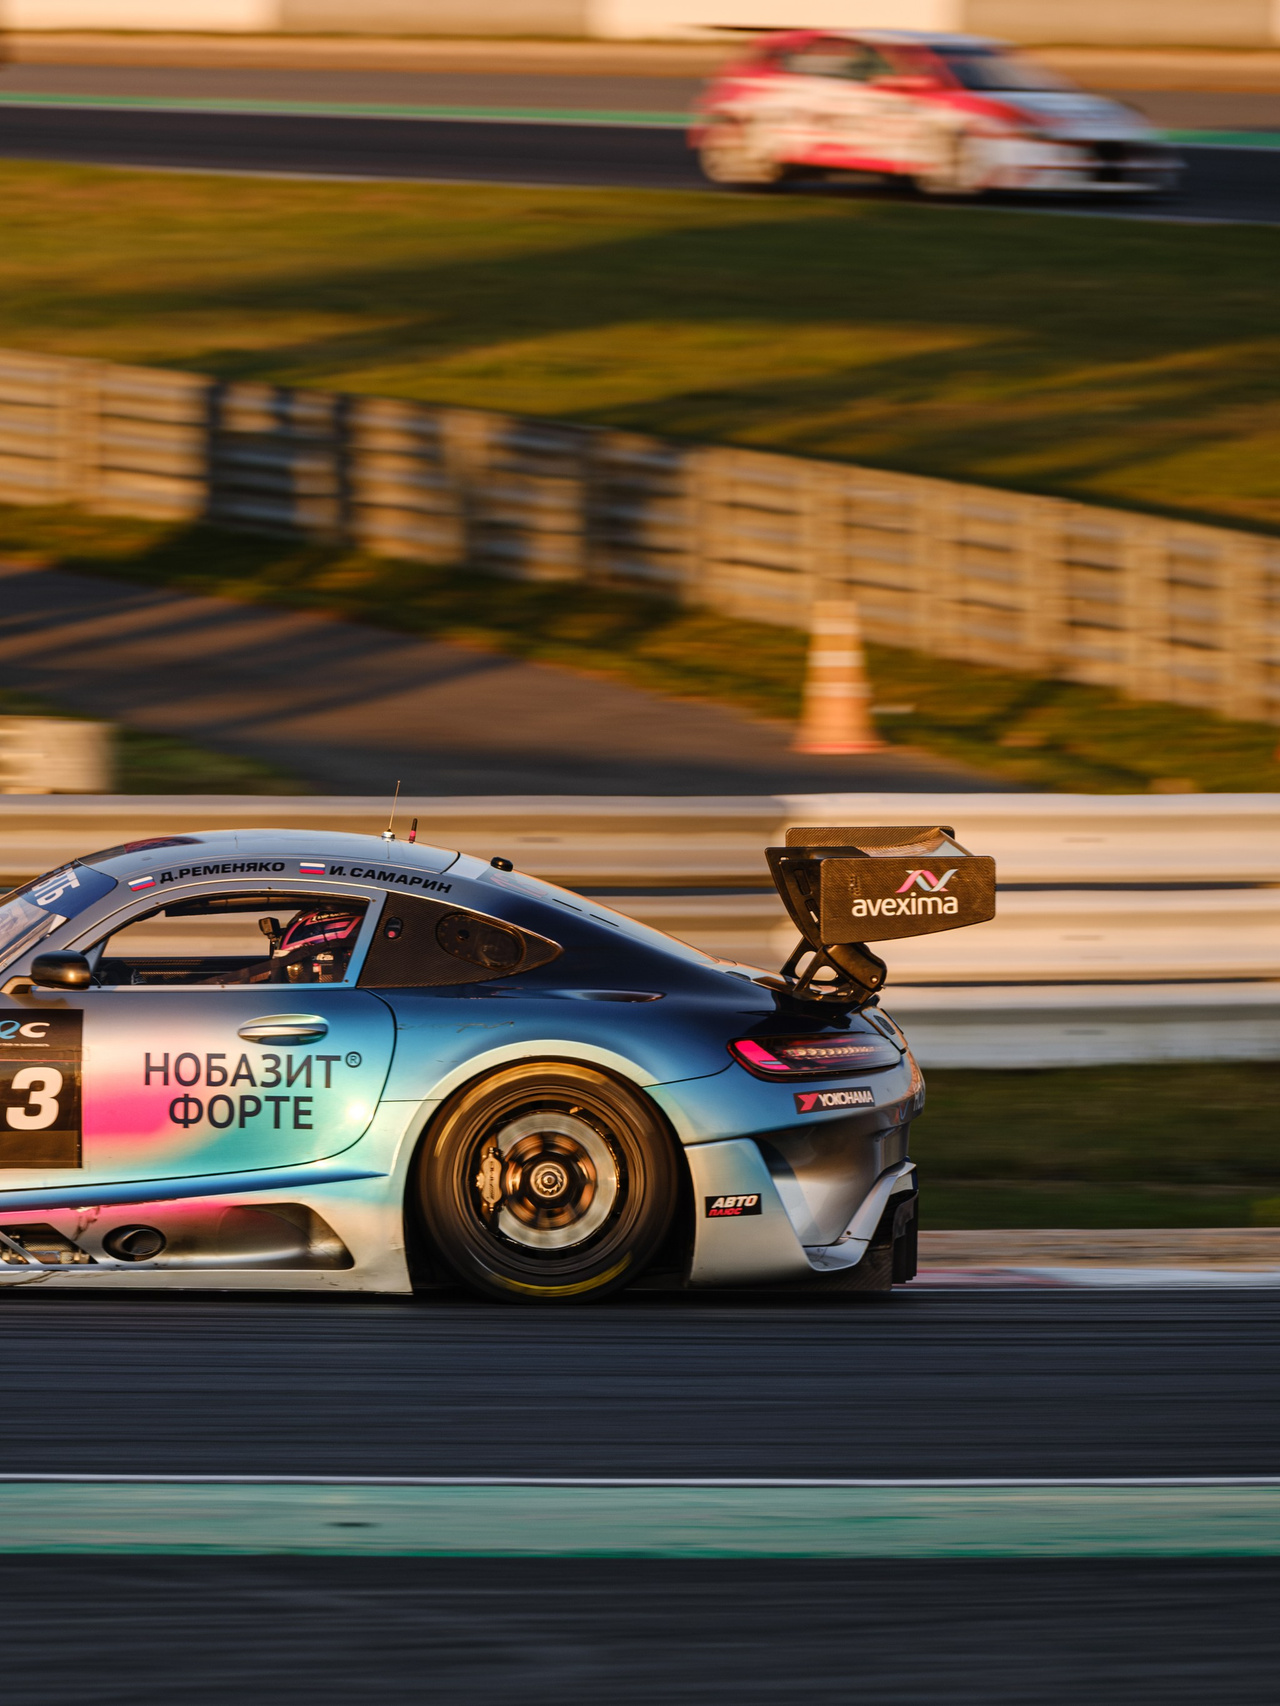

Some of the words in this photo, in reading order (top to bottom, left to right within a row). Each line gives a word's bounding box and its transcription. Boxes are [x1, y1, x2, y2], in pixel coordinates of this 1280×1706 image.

[159, 861, 285, 884] Д.РЕМЕНЯКО
[851, 892, 959, 917] avexima
[818, 1090, 875, 1107] YOKOHAMA
[169, 1093, 314, 1130] ФОРТЕ
[711, 1195, 759, 1208] АВТО
